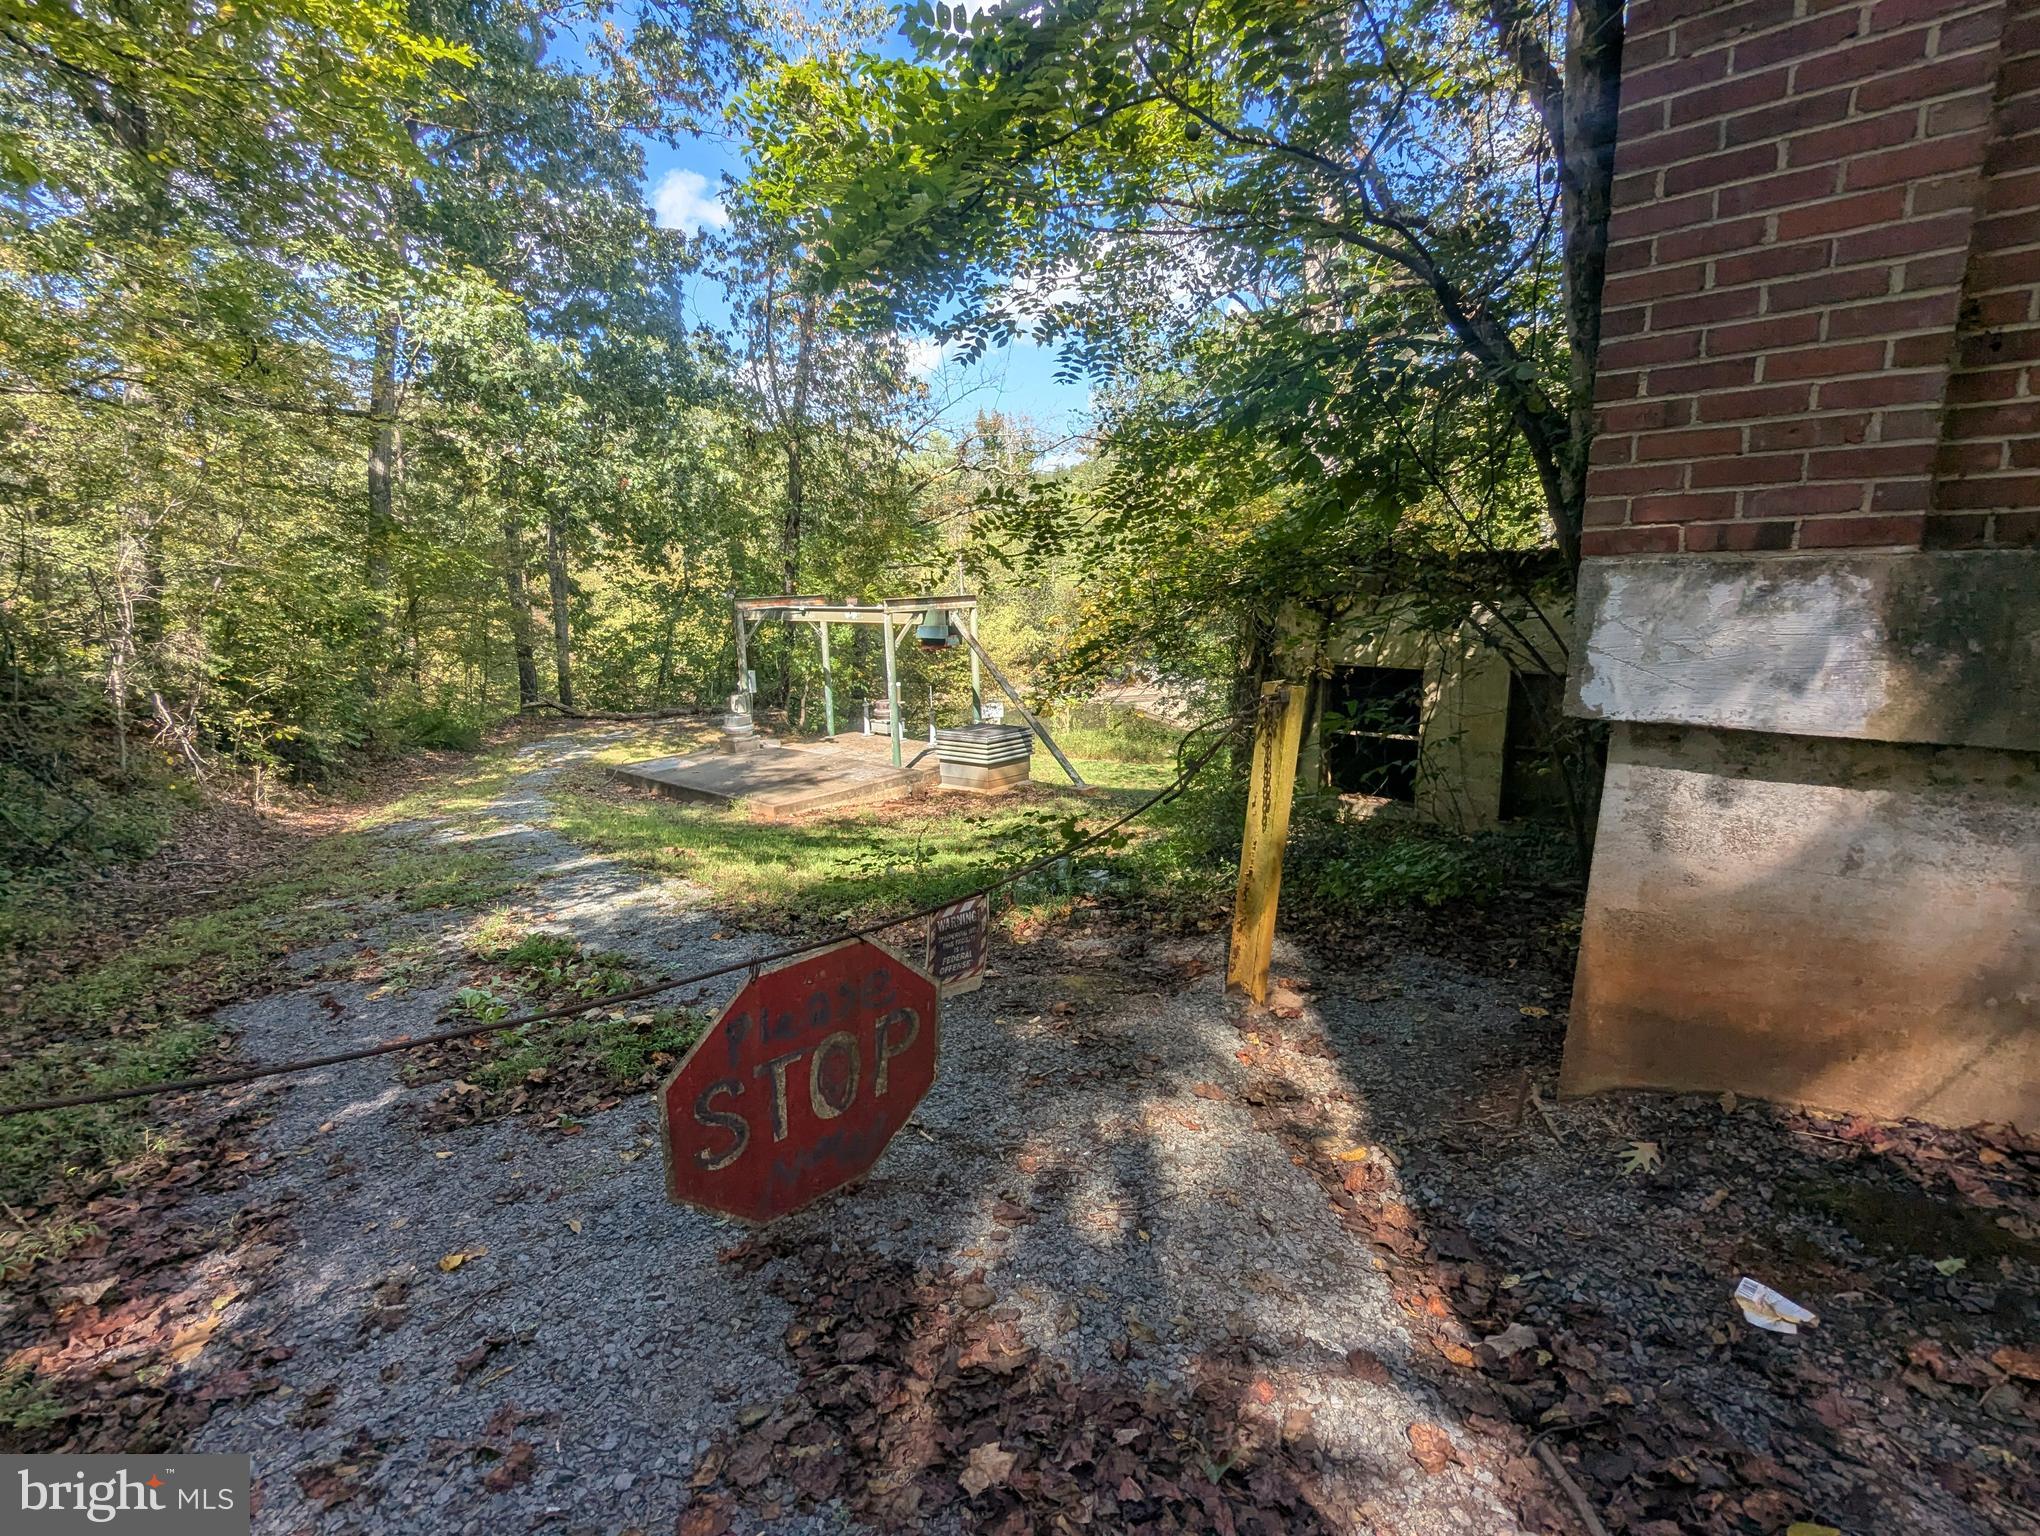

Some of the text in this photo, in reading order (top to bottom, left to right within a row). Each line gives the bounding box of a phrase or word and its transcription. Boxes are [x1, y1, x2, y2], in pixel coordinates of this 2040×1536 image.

[937, 909, 978, 932] WARNING
[939, 959, 973, 976] OFFENSE
[942, 950, 973, 966] FEDERAL
[694, 1007, 921, 1171] STOP
